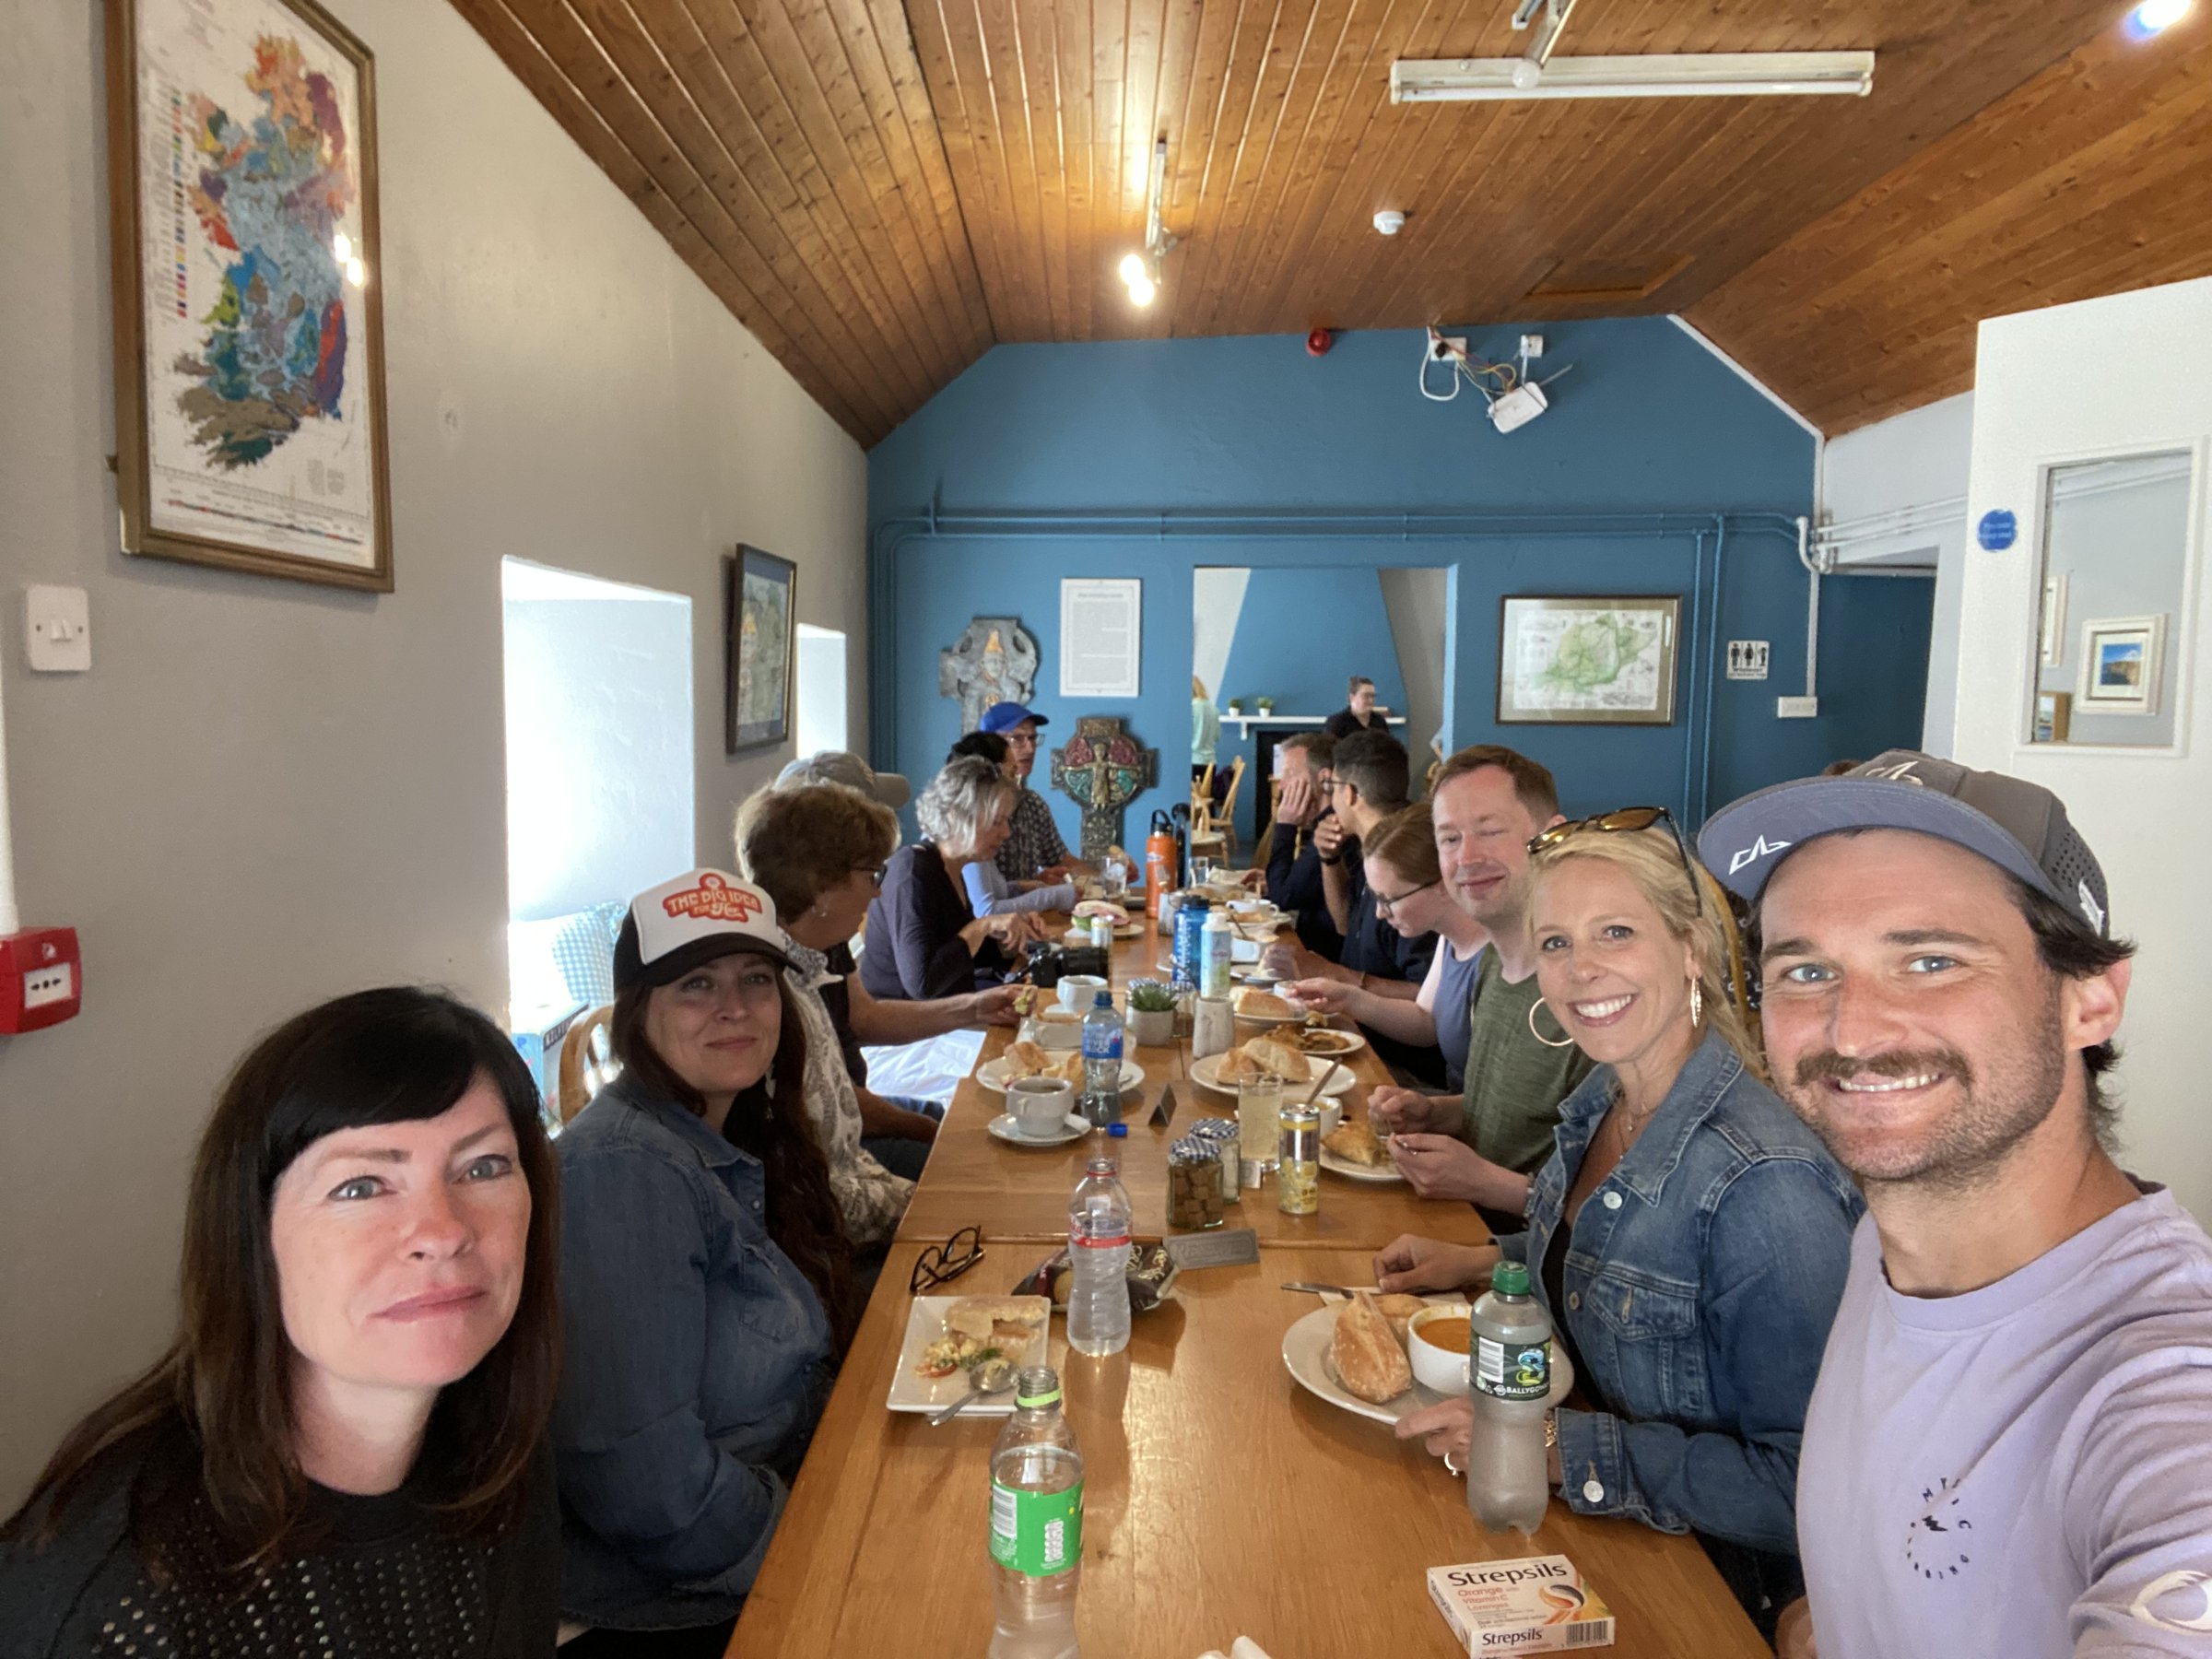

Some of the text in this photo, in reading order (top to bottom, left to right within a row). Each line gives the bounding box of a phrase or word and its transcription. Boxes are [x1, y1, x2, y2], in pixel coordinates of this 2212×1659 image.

[667, 891, 699, 912] THE
[1447, 1563, 1567, 1586] Strepsils
[1458, 1587, 1502, 1596] Orange
[1462, 1595, 1499, 1604] Vitamin
[1481, 1628, 1544, 1646] Strepsils
